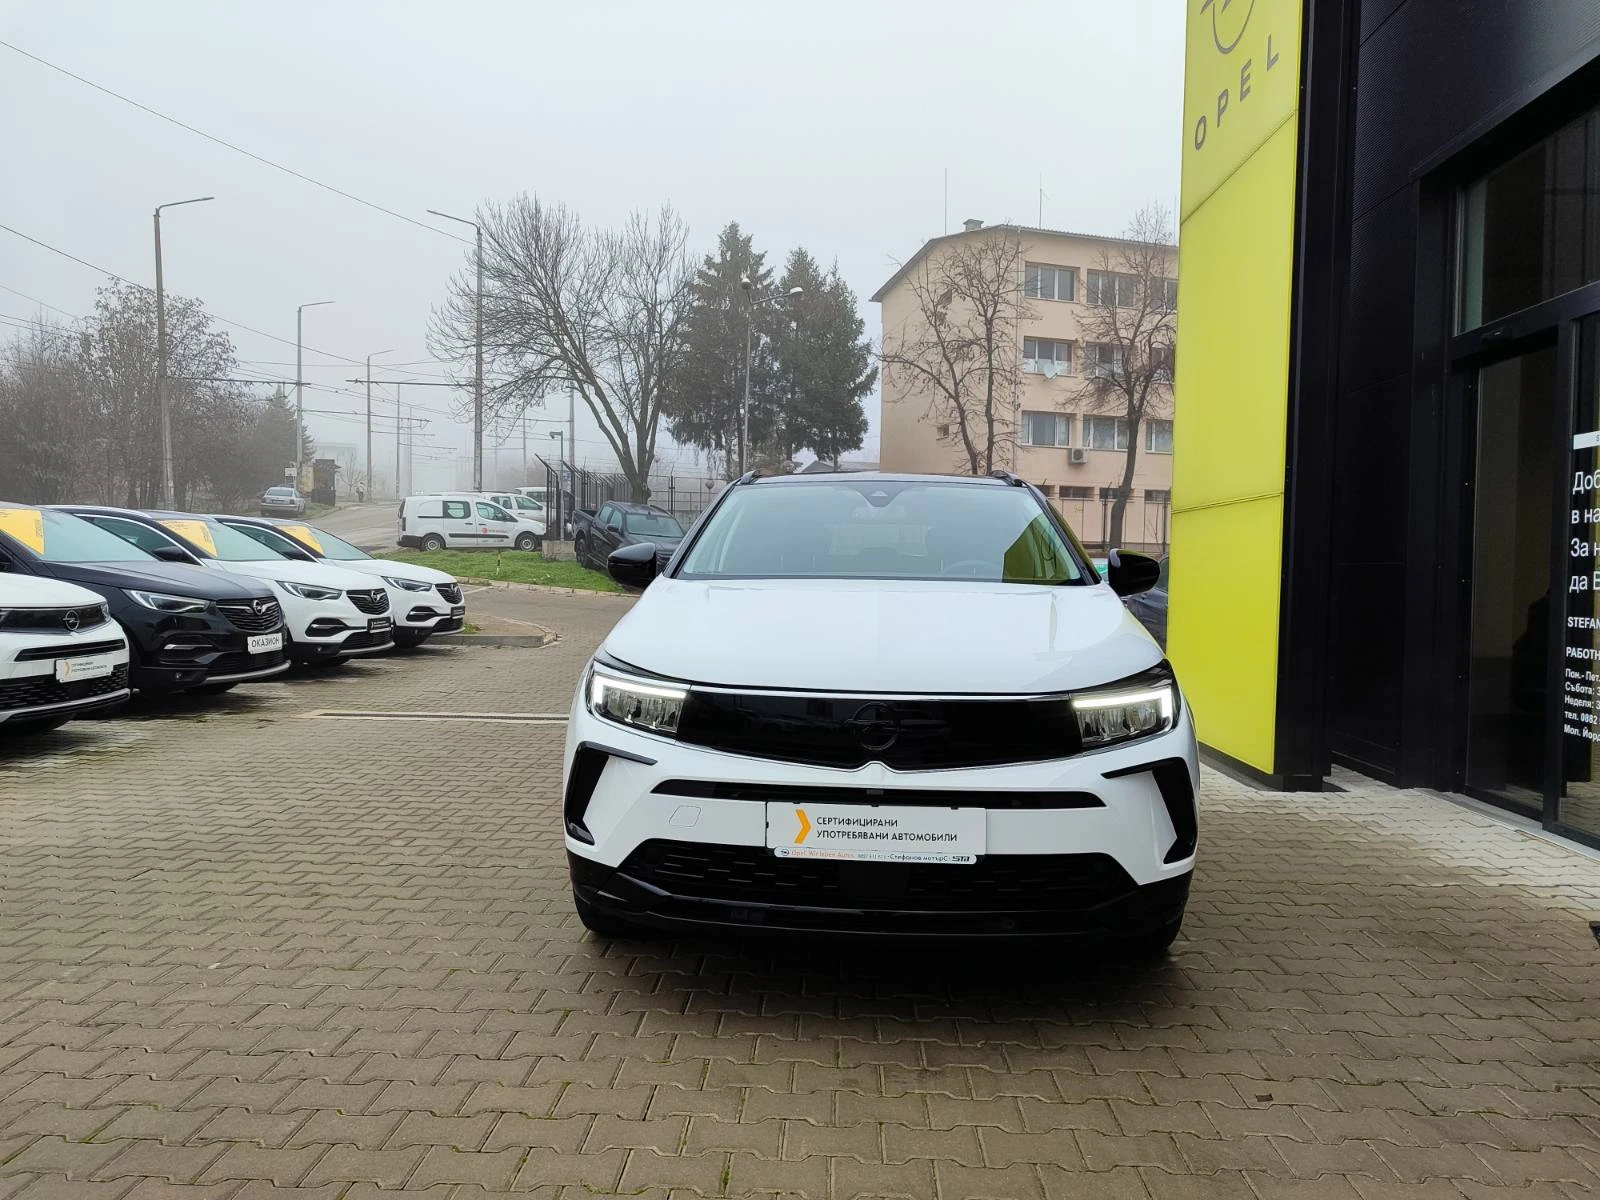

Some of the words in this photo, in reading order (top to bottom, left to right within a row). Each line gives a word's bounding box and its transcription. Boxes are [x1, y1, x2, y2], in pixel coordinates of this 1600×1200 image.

[1195, 34, 1279, 150] OPEL
[1571, 509, 1580, 524] в
[1570, 537, 1589, 557] За
[1569, 574, 1588, 594] да
[251, 636, 280, 648] ОКАЗИОН
[816, 816, 898, 828] СЕРТИФИЦИРАНИ
[816, 830, 889, 841] УПОТРЕБЯВАНИ
[891, 832, 958, 843] АВТОМОБИЛИ
